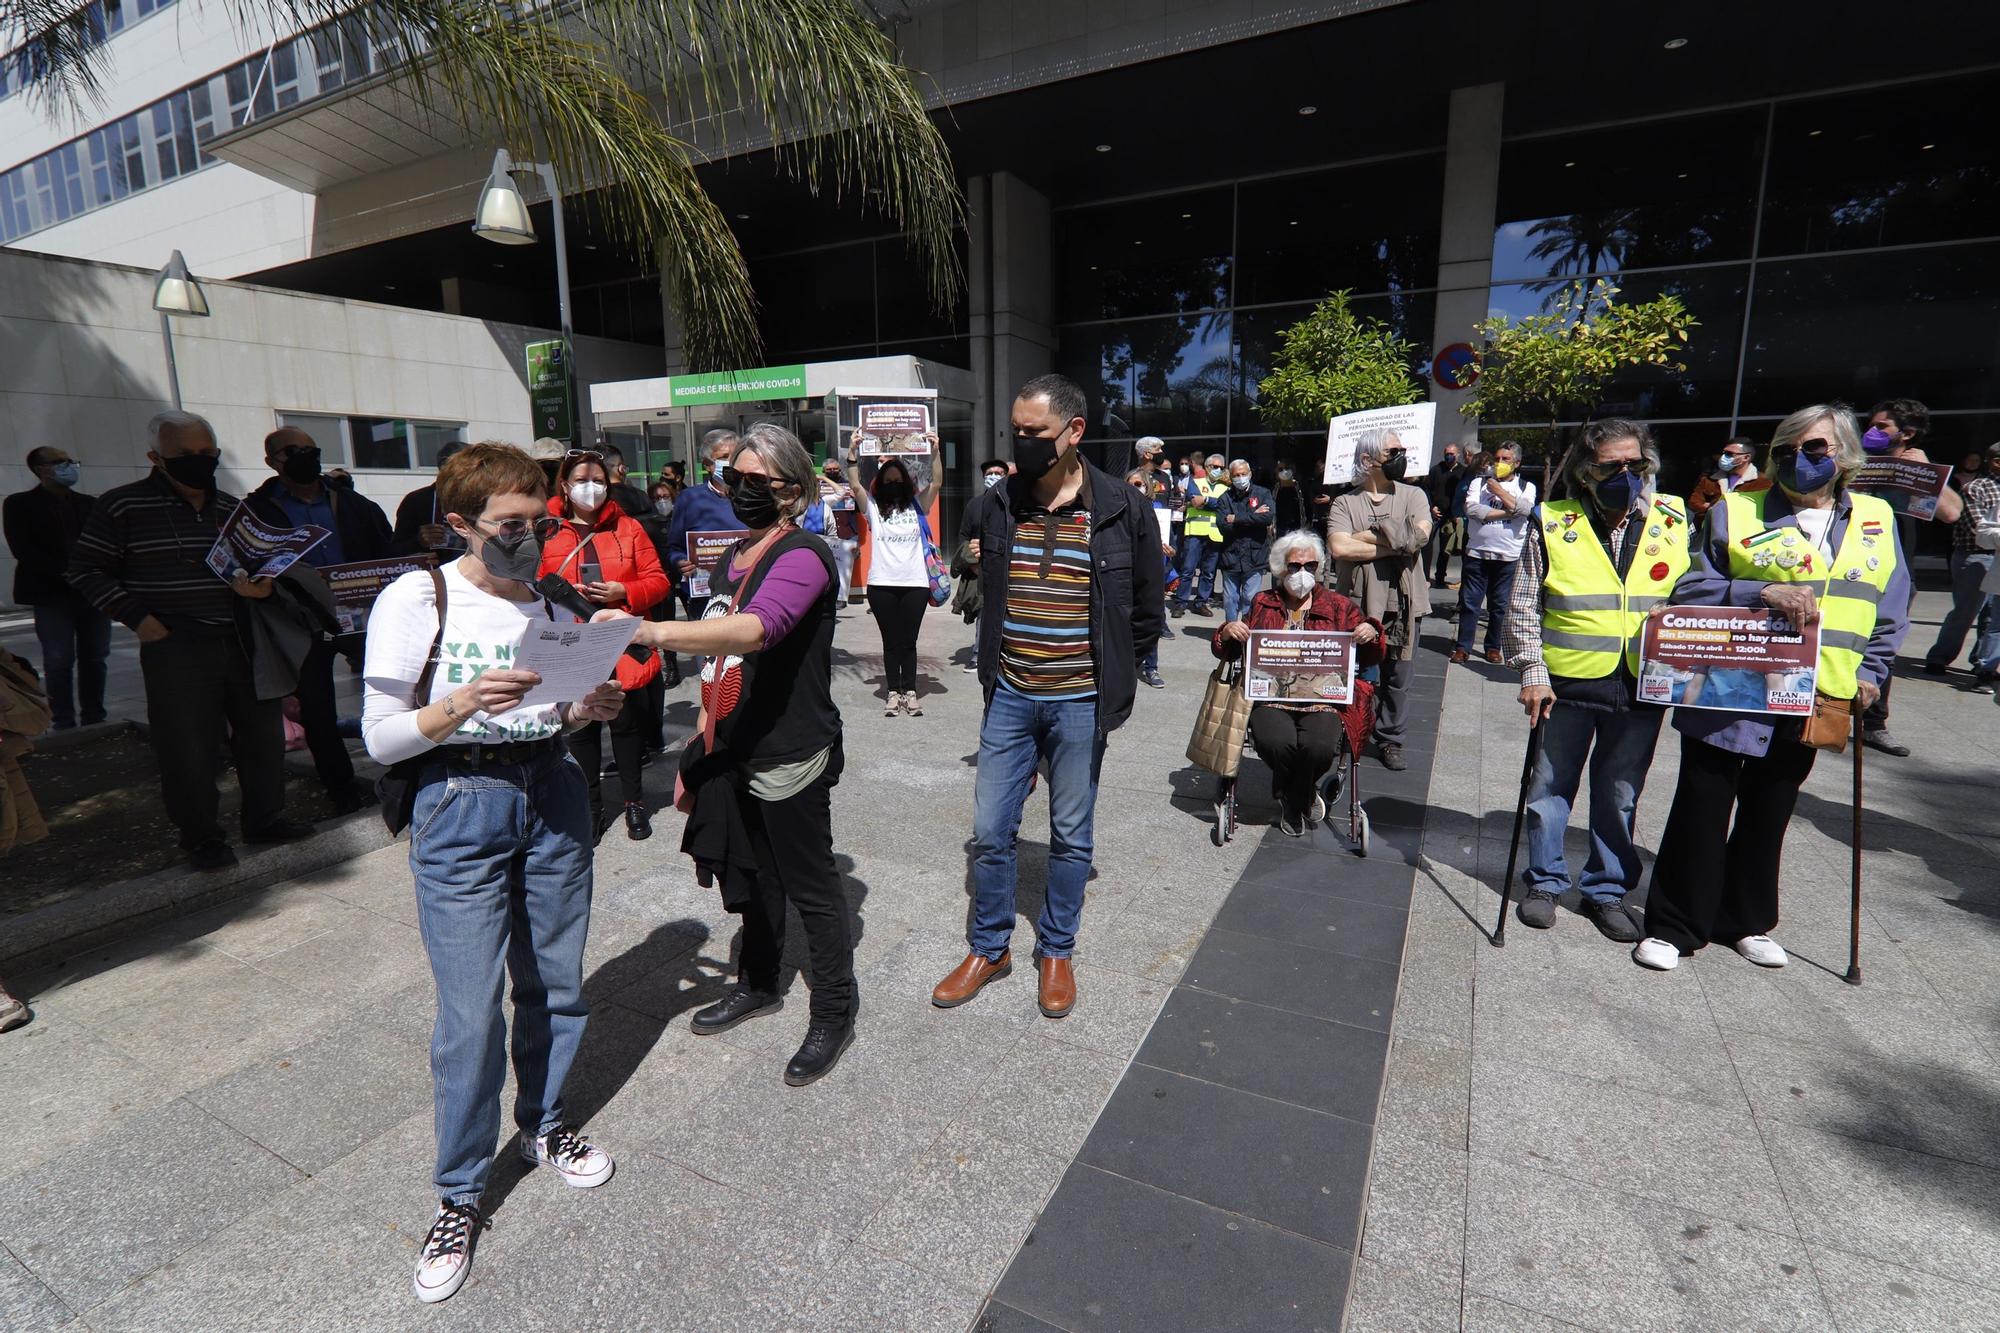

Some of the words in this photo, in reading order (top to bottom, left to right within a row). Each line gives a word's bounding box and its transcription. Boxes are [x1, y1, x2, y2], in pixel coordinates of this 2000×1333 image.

[675, 384, 706, 396] MEDIDAS
[708, 384, 717, 393] DE
[718, 380, 765, 392] PREVENCIÓN
[766, 378, 800, 389] COVID-19
[1366, 414, 1393, 423] DIGNIDAD
[1861, 462, 1938, 478] oncentración.
[1260, 638, 1342, 648] Concentración.
[1658, 630, 1676, 640] Sin
[1676, 632, 1728, 642] Derechos
[1732, 634, 1746, 642] no
[1748, 633, 1770, 645] hay
[1771, 634, 1803, 644] salud
[446, 642, 483, 658] YA
[1736, 646, 1766, 654] 12:00h
